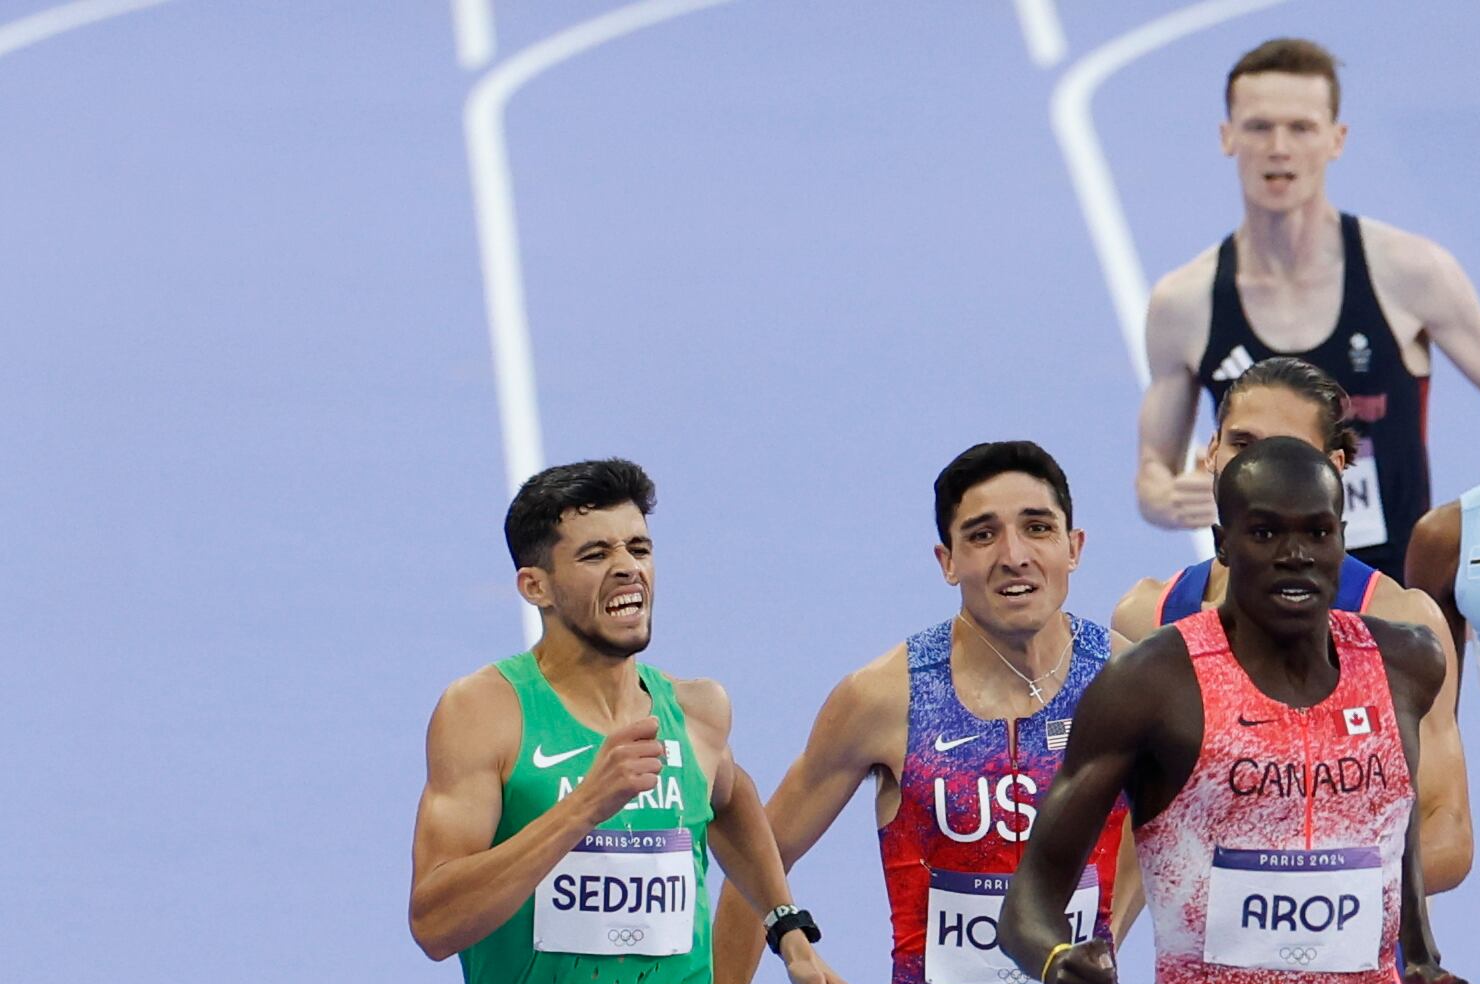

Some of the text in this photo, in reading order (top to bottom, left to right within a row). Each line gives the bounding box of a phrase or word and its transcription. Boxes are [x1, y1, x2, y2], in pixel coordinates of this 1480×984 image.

[1229, 754, 1387, 798] CANADA
[934, 773, 1037, 843] US
[585, 835, 628, 848] PARIS
[1259, 854, 1345, 866] PARIS 2024
[552, 874, 686, 913] SEDJATI
[974, 878, 1009, 890] PARI
[1241, 893, 1361, 932] AROP
